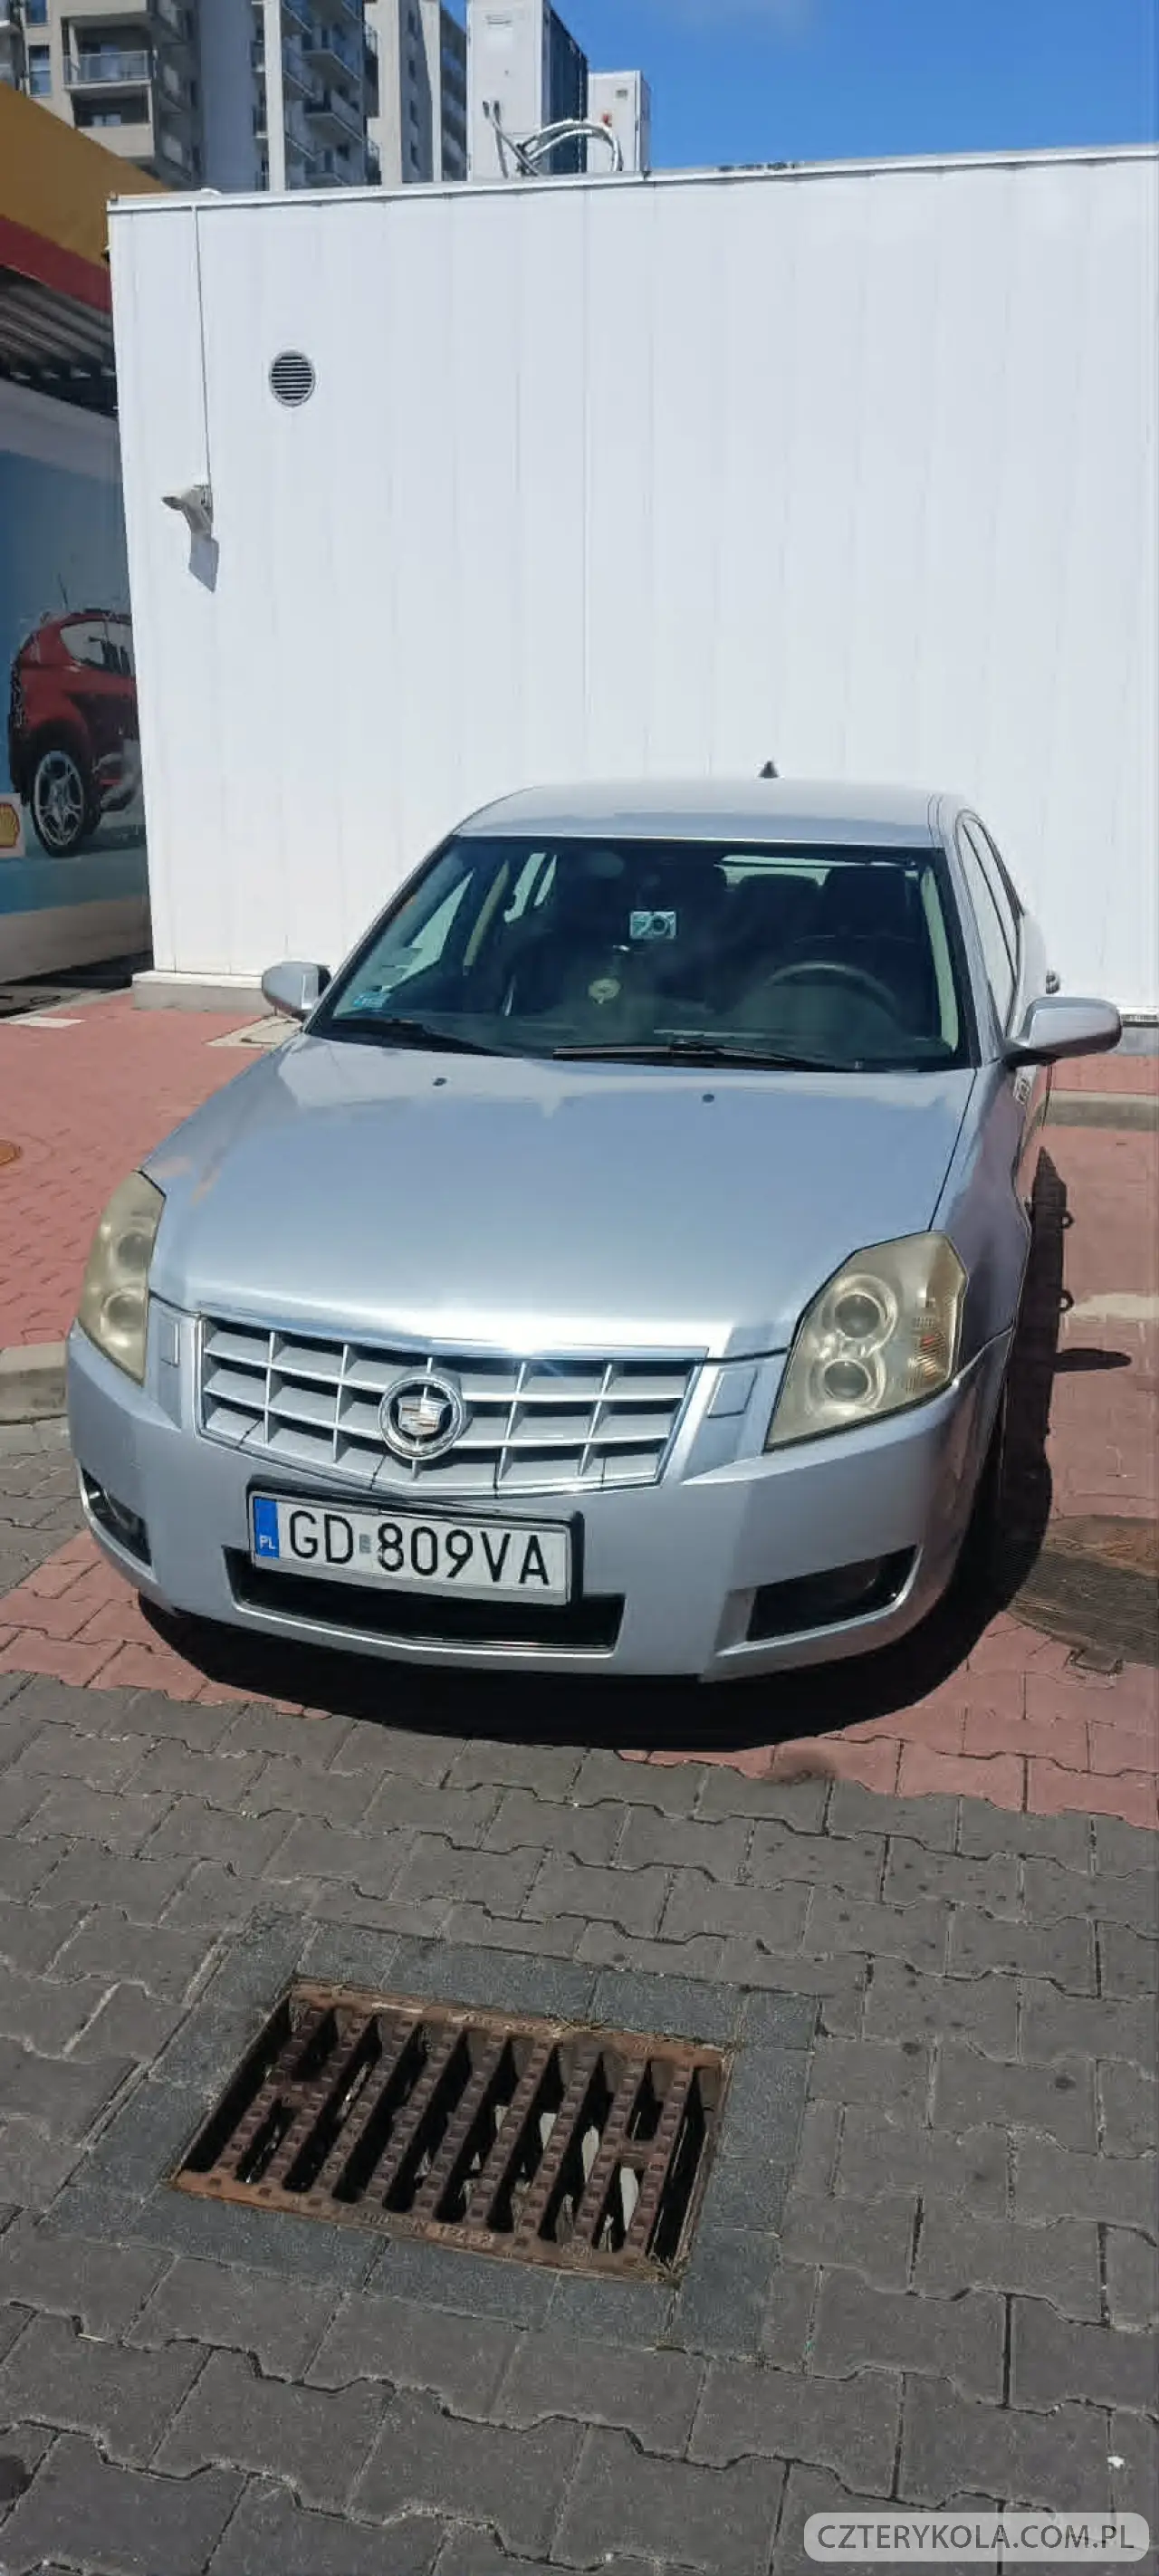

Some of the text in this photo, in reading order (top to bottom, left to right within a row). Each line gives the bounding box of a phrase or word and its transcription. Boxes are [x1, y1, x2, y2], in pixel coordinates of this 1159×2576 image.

[259, 1535, 276, 1549] PL
[289, 1510, 550, 1585] GD 809VA
